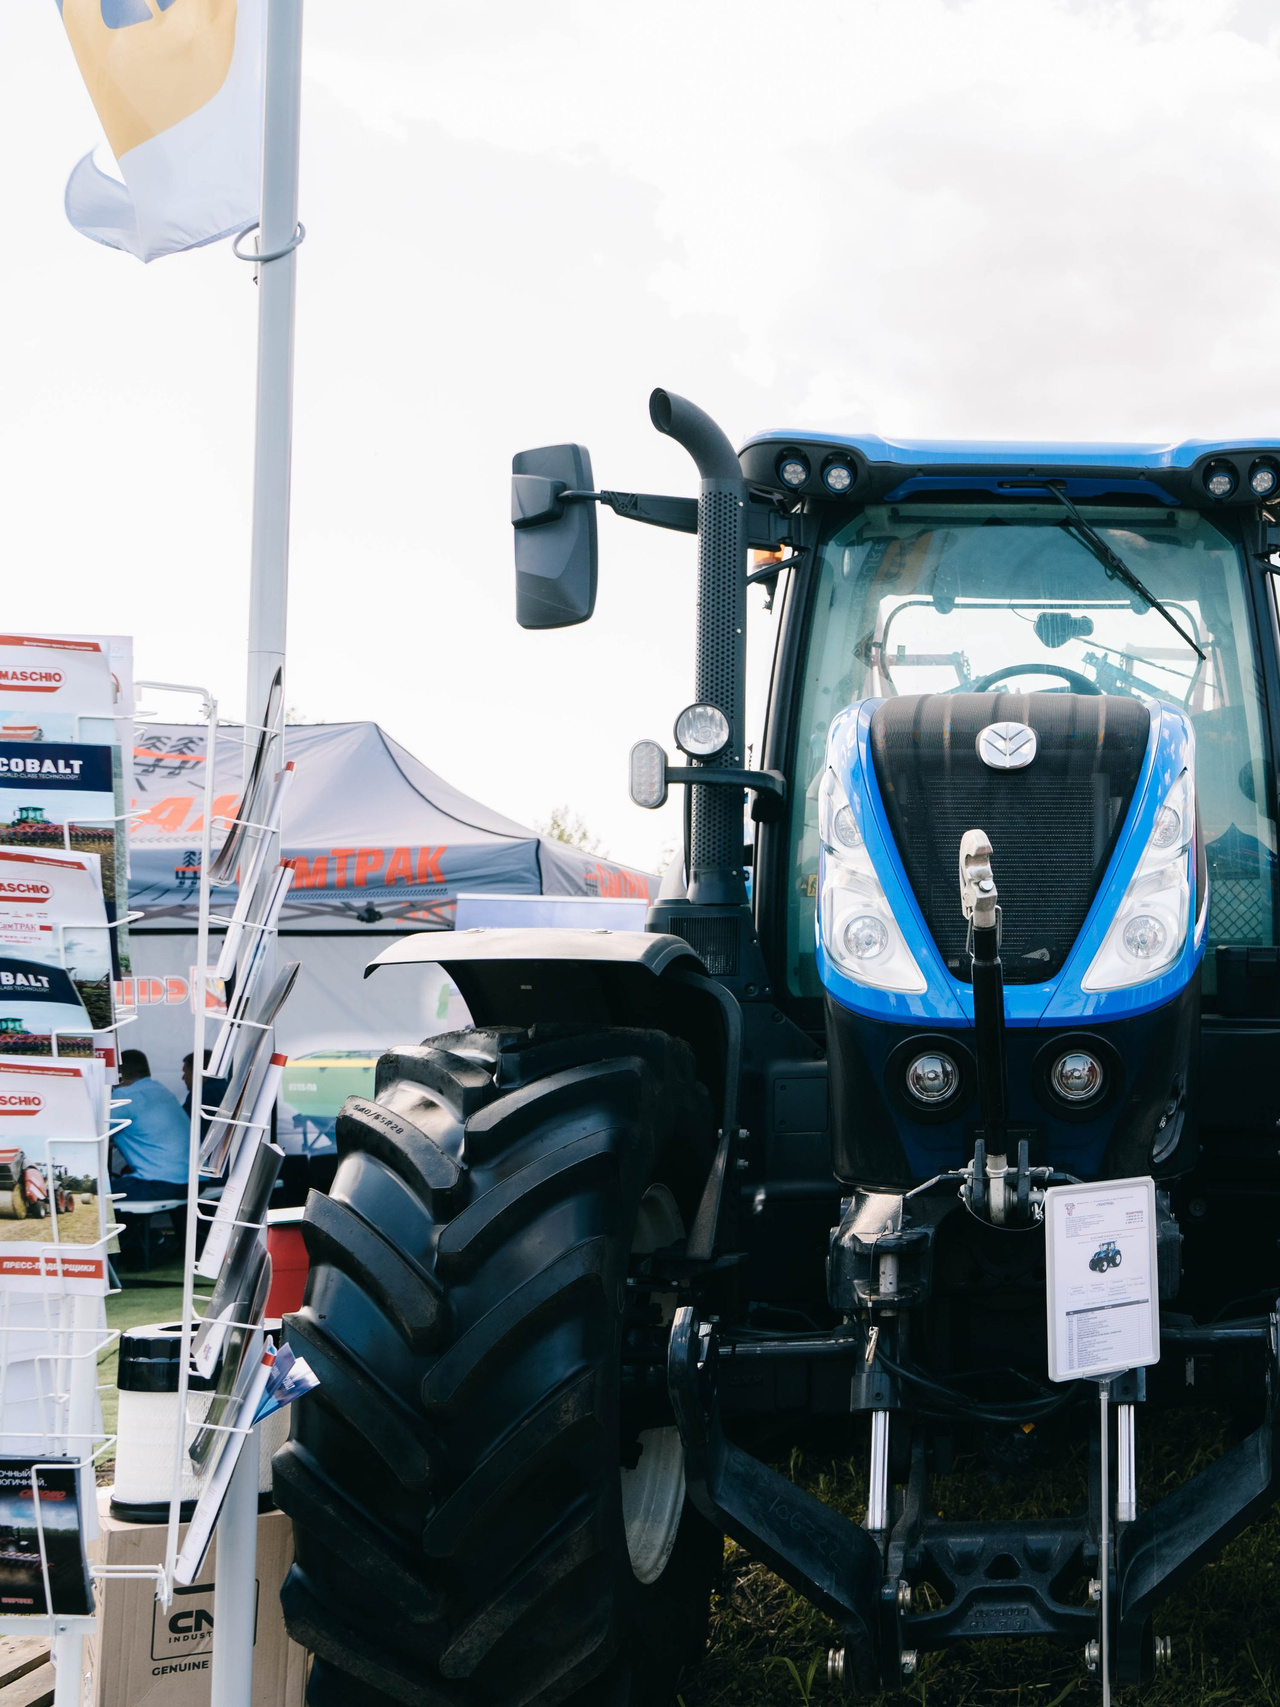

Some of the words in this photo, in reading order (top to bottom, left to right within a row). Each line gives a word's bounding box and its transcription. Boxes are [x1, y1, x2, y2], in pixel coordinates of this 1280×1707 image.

[0, 670, 62, 683] MASCHIO
[289, 845, 449, 889] МТРАК
[352, 1104, 405, 1135] 540/65R28
[168, 1630, 213, 1643] INDUST
[151, 1660, 210, 1676] GENUINE
